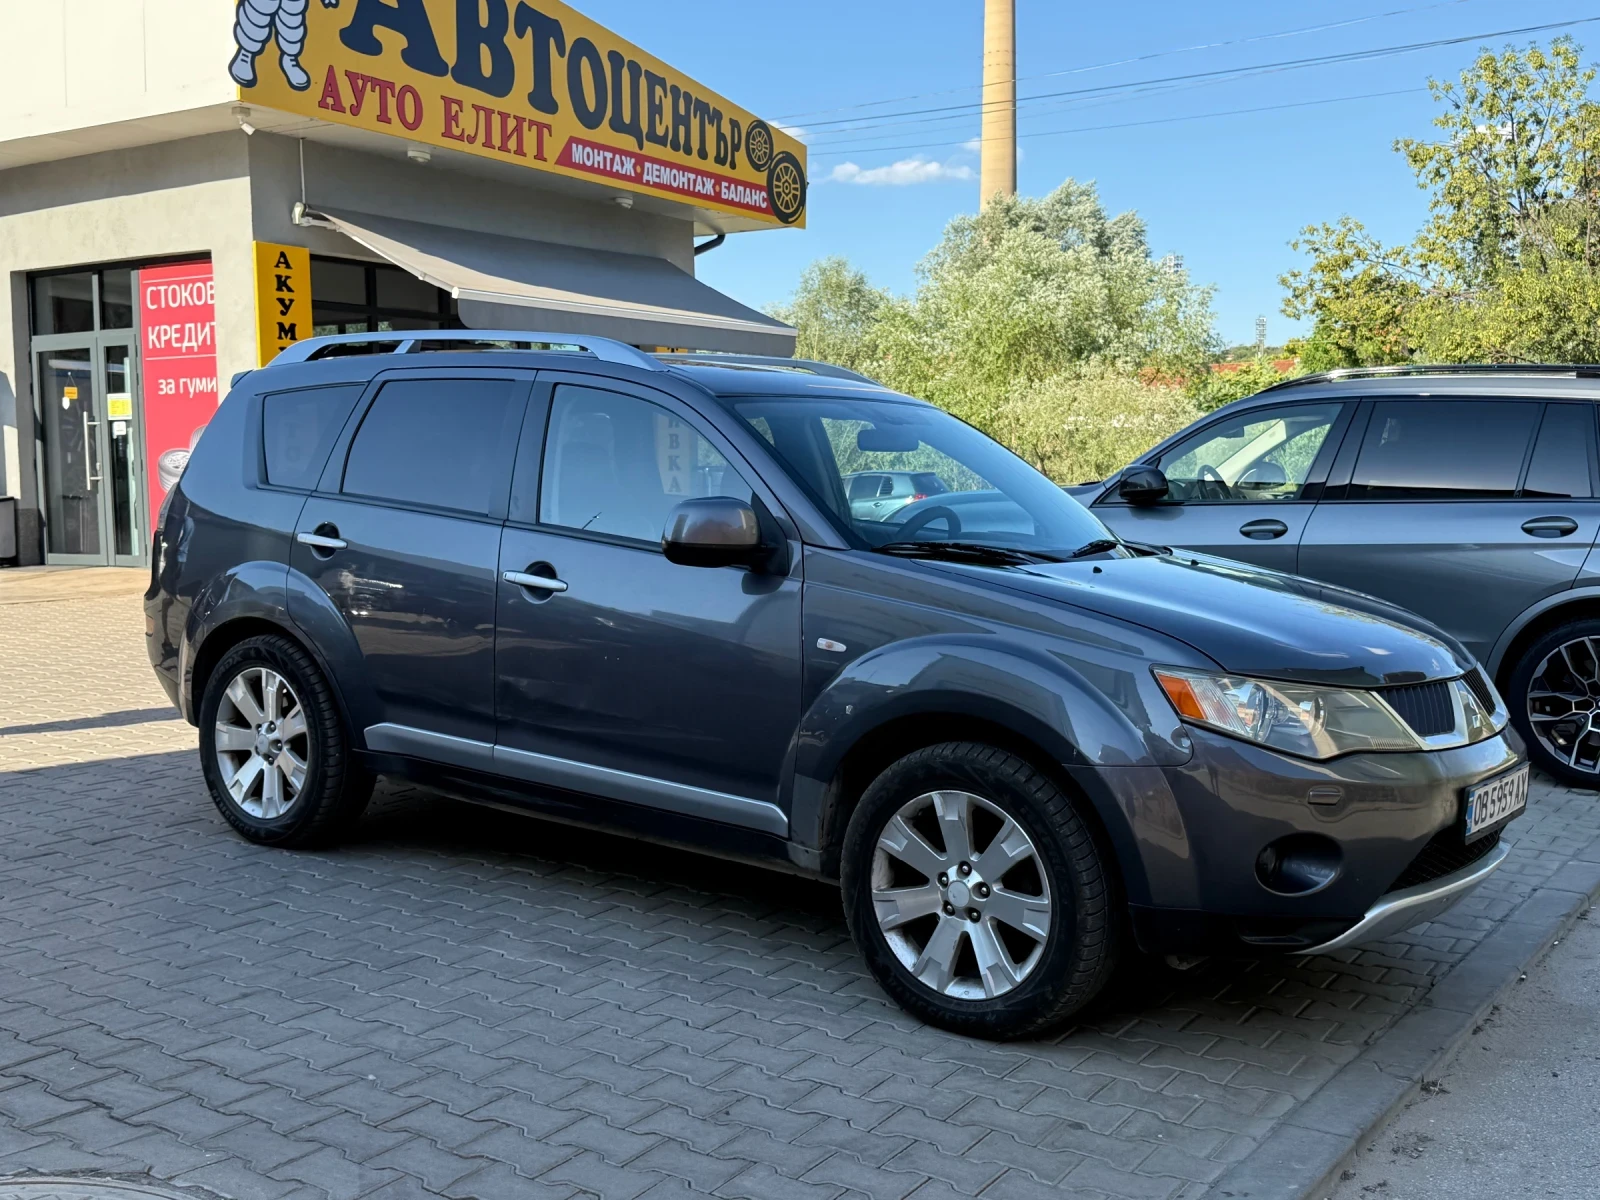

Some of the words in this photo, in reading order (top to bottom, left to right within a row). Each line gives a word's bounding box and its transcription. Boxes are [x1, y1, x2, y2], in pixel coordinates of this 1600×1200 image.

[318, 64, 424, 131] АУТО
[441, 95, 553, 162] ЕЛИТ
[339, 0, 742, 170] АВТОЦЕНТЪР
[572, 143, 636, 177] МОНТАЖ
[643, 161, 715, 197] ДЕМОНТАЖ
[721, 181, 768, 209] БАЛАНС
[274, 250, 298, 352] АКУМ
[158, 379, 175, 395] за
[180, 377, 217, 398] гуми
[1489, 779, 1515, 818] 5959
